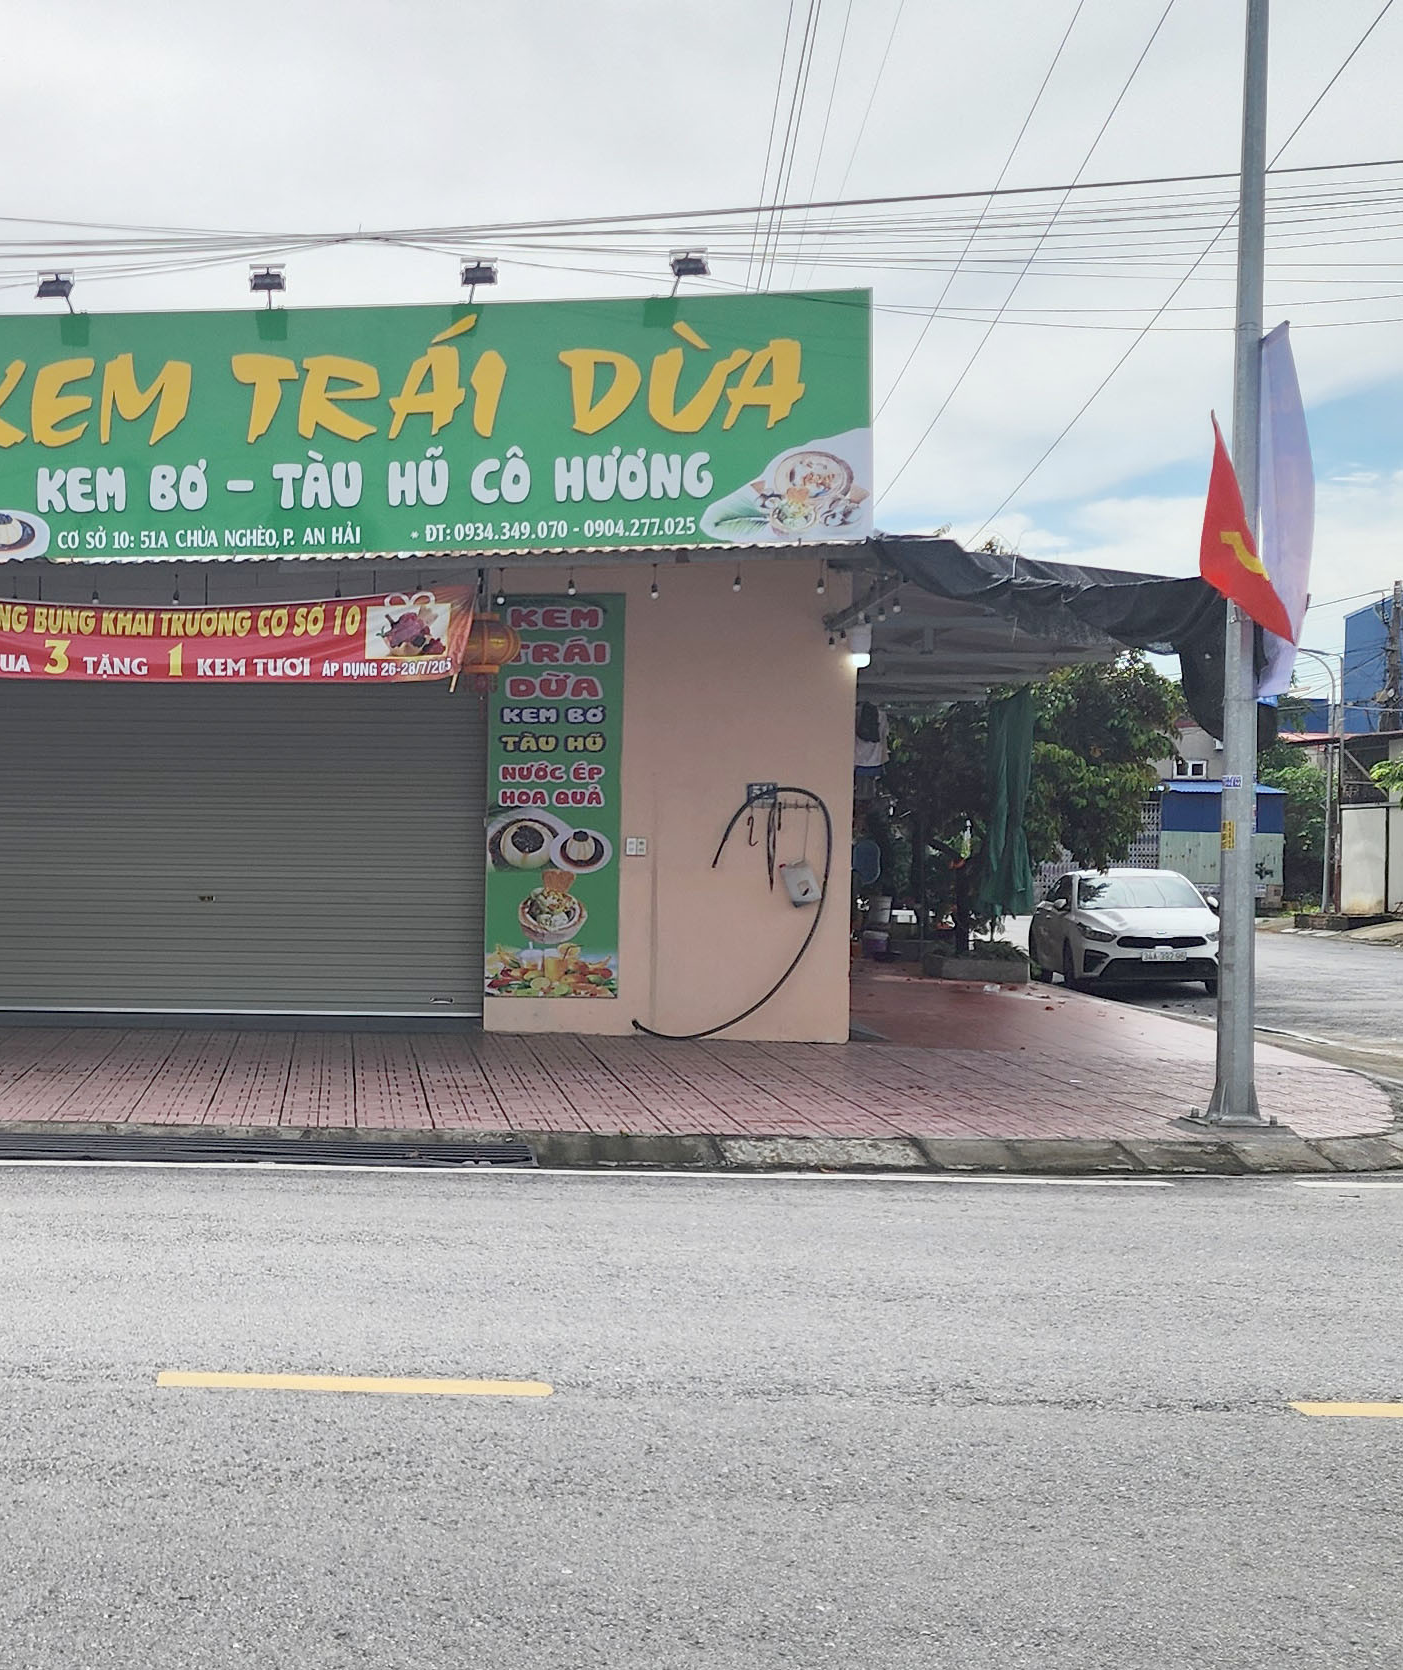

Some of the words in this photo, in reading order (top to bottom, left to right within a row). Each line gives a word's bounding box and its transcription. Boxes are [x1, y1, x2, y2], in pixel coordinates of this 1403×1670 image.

[231, 313, 507, 443] TRÁI
[557, 320, 805, 436] DỪA
[37, 466, 126, 513] KEM
[149, 459, 208, 512] BƠ
[272, 450, 363, 510] TÀU
[387, 446, 449, 507] HŨ
[470, 445, 531, 504] CÔ
[554, 445, 713, 504] HƯƠNG
[57, 530, 79, 549] CƠ
[86, 526, 106, 549] SỞ
[112, 531, 135, 549] 10:
[140, 530, 169, 549] 51A
[175, 526, 218, 548] CHÙA
[303, 527, 325, 546] AN
[331, 522, 361, 545] HẢI
[454, 519, 568, 542] 0934.349.070
[584, 516, 696, 538] 0904.277.025
[101, 611, 155, 636] KHAI
[333, 605, 361, 636] 10
[508, 607, 603, 629] KEM
[44, 639, 71, 674] 3
[82, 653, 148, 679] TẶNG
[168, 641, 183, 676] 1
[197, 658, 246, 677] KEM
[252, 656, 311, 677] TƯƠI
[321, 661, 341, 677] ÁP
[342, 662, 377, 679] DỤNG
[513, 637, 610, 665] TRÁI
[502, 708, 557, 724] KEM
[567, 707, 605, 724] BƠ
[501, 733, 556, 751] TÀU
[567, 734, 604, 751] HŨ
[501, 763, 566, 782] NƯỚC
[571, 763, 604, 781] ÉP
[500, 790, 547, 806] HOA
[554, 787, 604, 806] QUẢ
